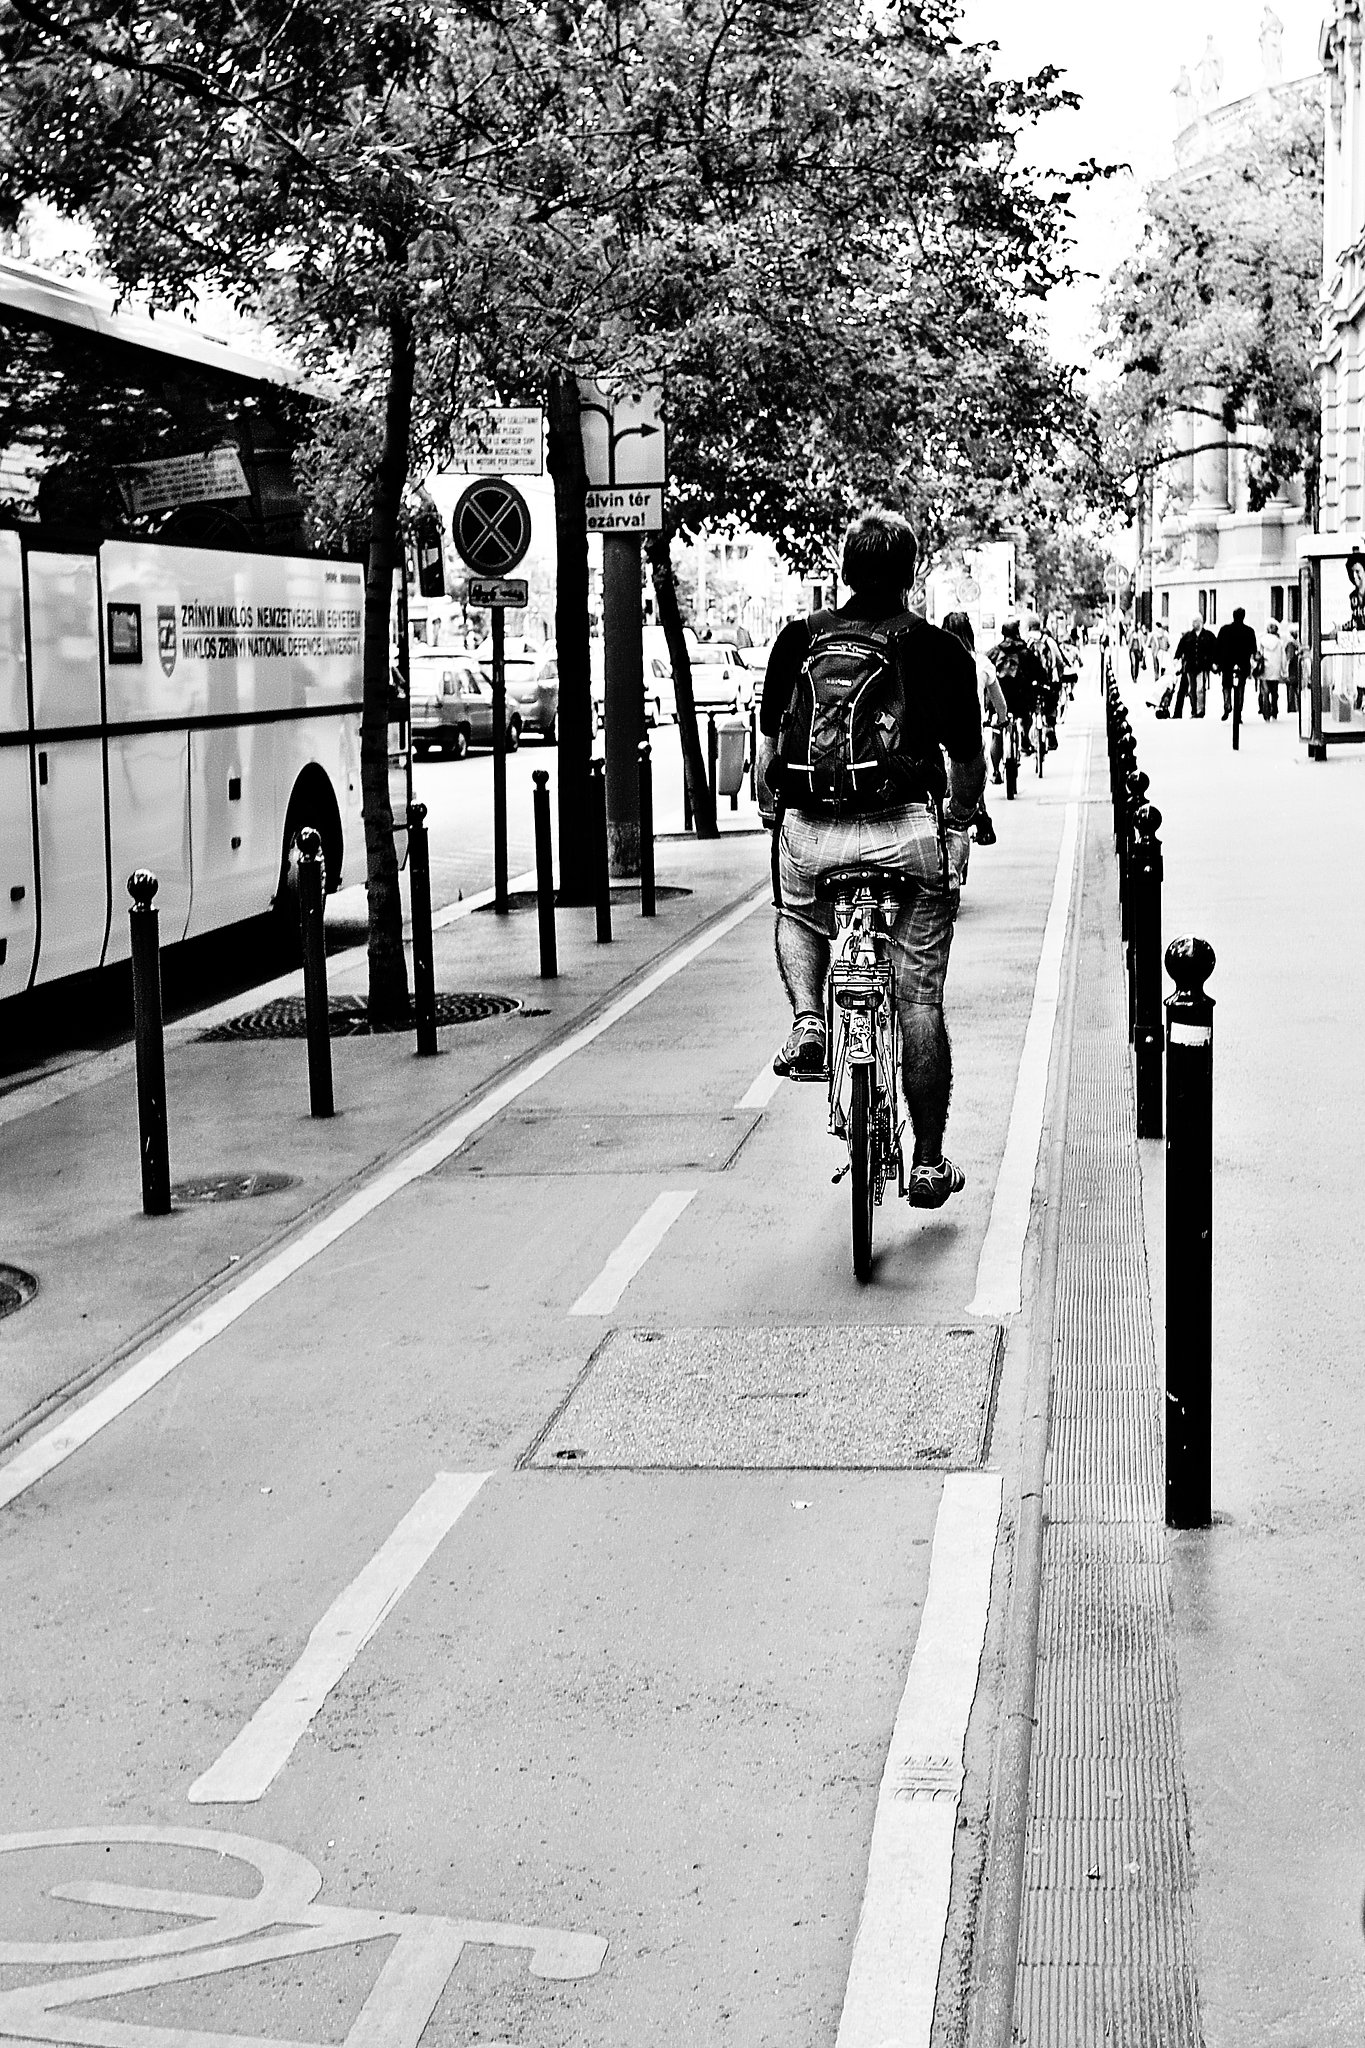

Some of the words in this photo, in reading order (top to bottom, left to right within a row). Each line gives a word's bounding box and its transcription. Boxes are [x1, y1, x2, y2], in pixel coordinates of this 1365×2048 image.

[585, 492, 624, 508] álvin
[628, 491, 651, 507] tér
[587, 512, 646, 529] ezárva!
[181, 599, 215, 628] ZRÍNYI
[216, 600, 253, 628] MIKLÓS
[247, 636, 287, 659] NATIONAL
